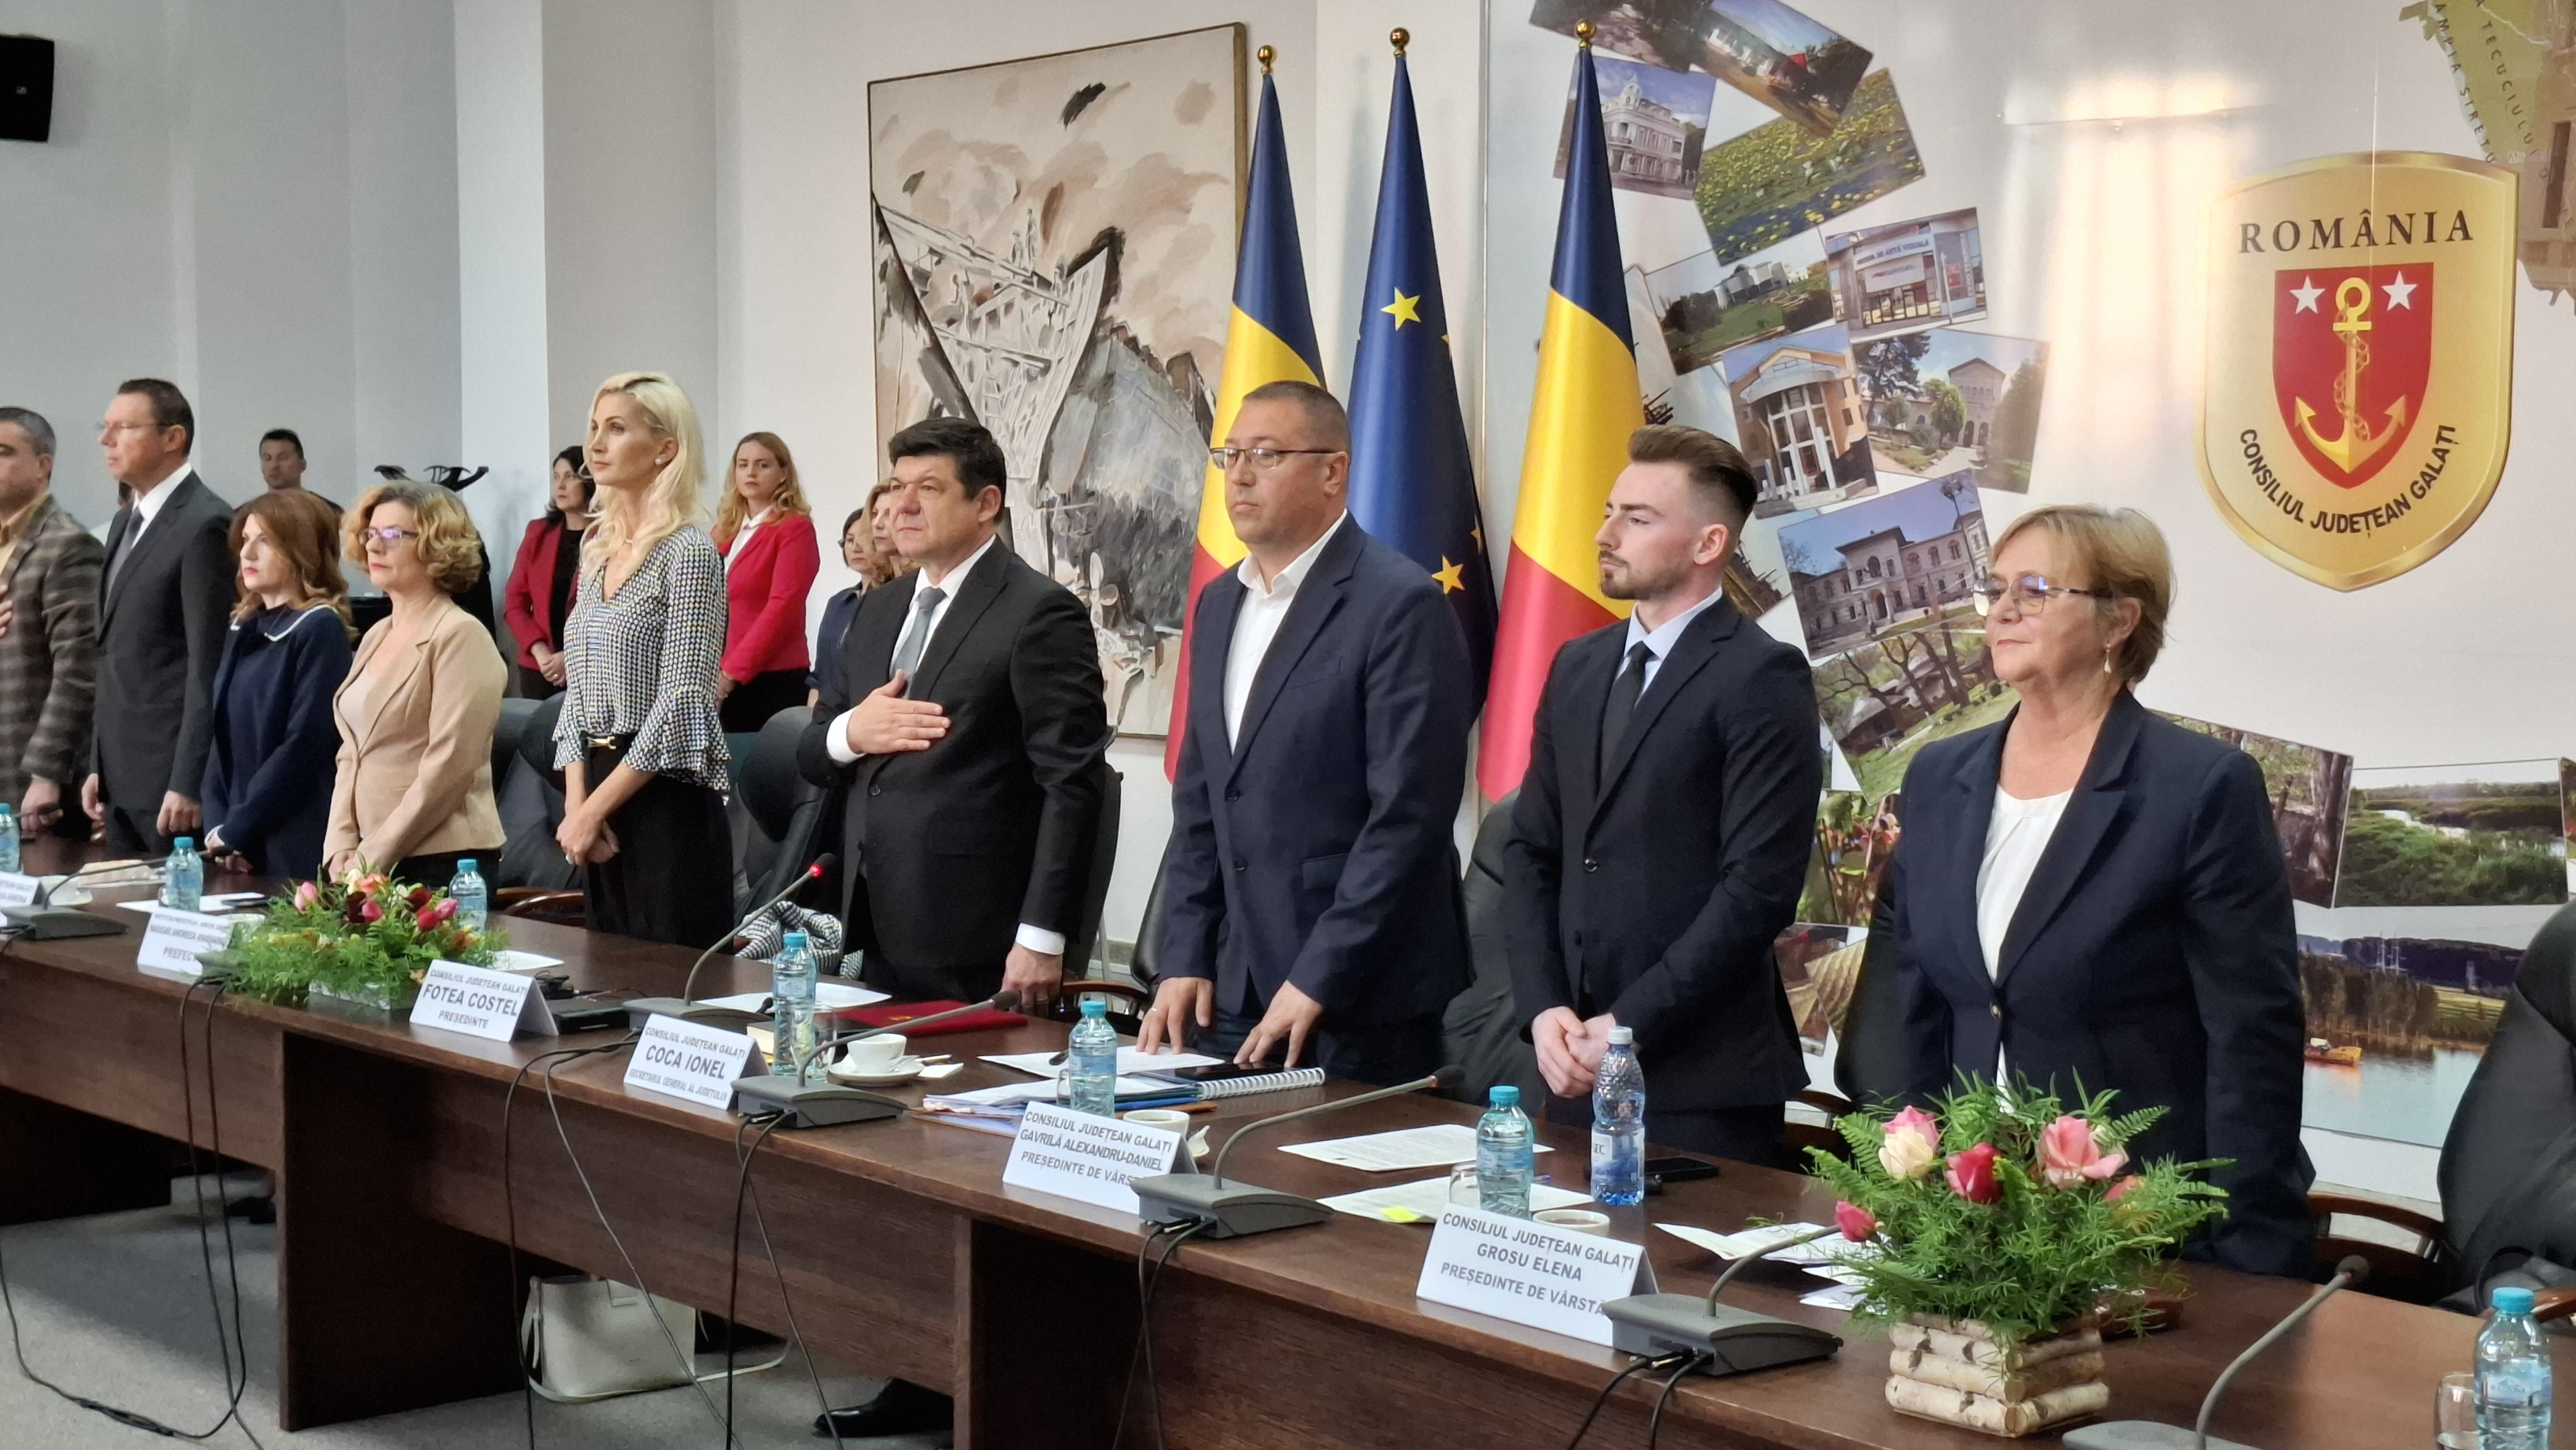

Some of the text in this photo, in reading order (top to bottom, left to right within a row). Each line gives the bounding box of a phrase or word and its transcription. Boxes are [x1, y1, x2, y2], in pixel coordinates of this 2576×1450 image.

[2239, 208, 2473, 253] ROMÂNIA
[2240, 424, 2459, 539] CONSILIUL JUDEȚEAN GALAȚI
[423, 984, 518, 1017] FOTEA COSTEL
[645, 1045, 727, 1079] COCA IONEL
[1025, 1111, 1172, 1154] CONSILIUL JUDEȚEAN GALAȚI
[1063, 1141, 1162, 1171] ALEXANDRU-DANIEL
[1087, 1166, 1101, 1179] DE
[1105, 1170, 1135, 1186] VÂRS
[1443, 1213, 1635, 1273] CONSILIUL JUDEȚEAN GALAȚI
[1477, 1243, 1582, 1281] GROSU ELENA
[1527, 1285, 1546, 1300] DE
